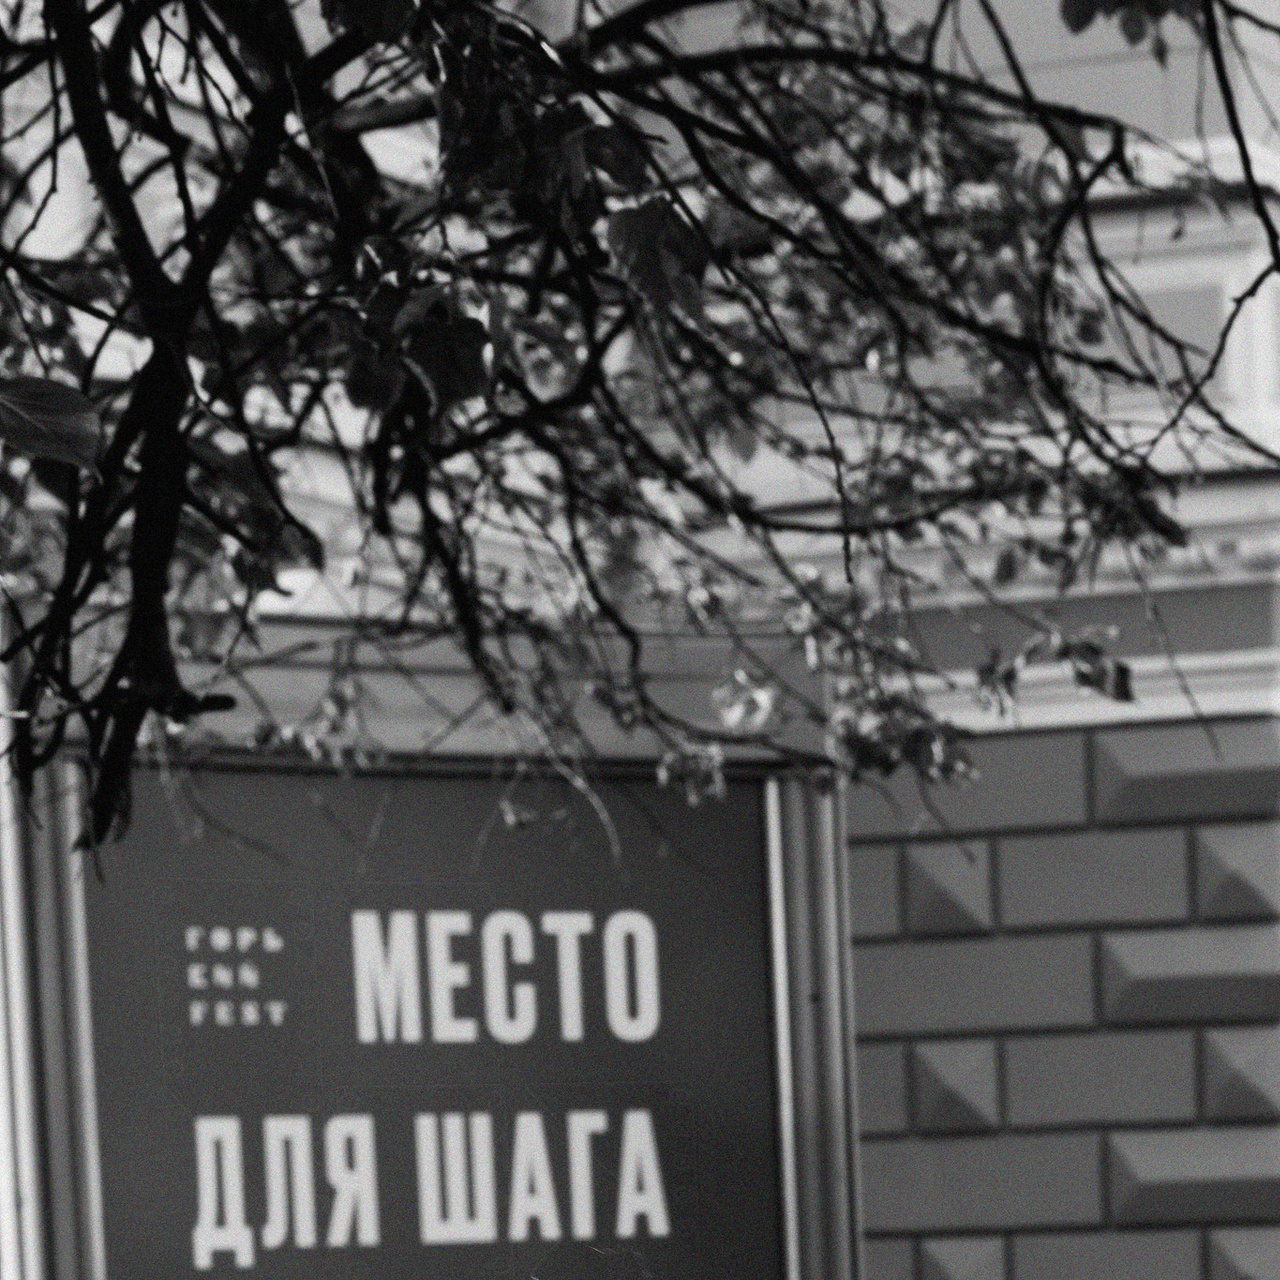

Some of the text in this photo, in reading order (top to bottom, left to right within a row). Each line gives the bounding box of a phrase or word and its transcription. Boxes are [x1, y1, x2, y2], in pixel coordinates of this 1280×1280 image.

[188, 999, 288, 1027] FEST
[350, 909, 661, 1045] МЕСТО
[191, 1109, 671, 1271] ДЛЯ ШАГА
